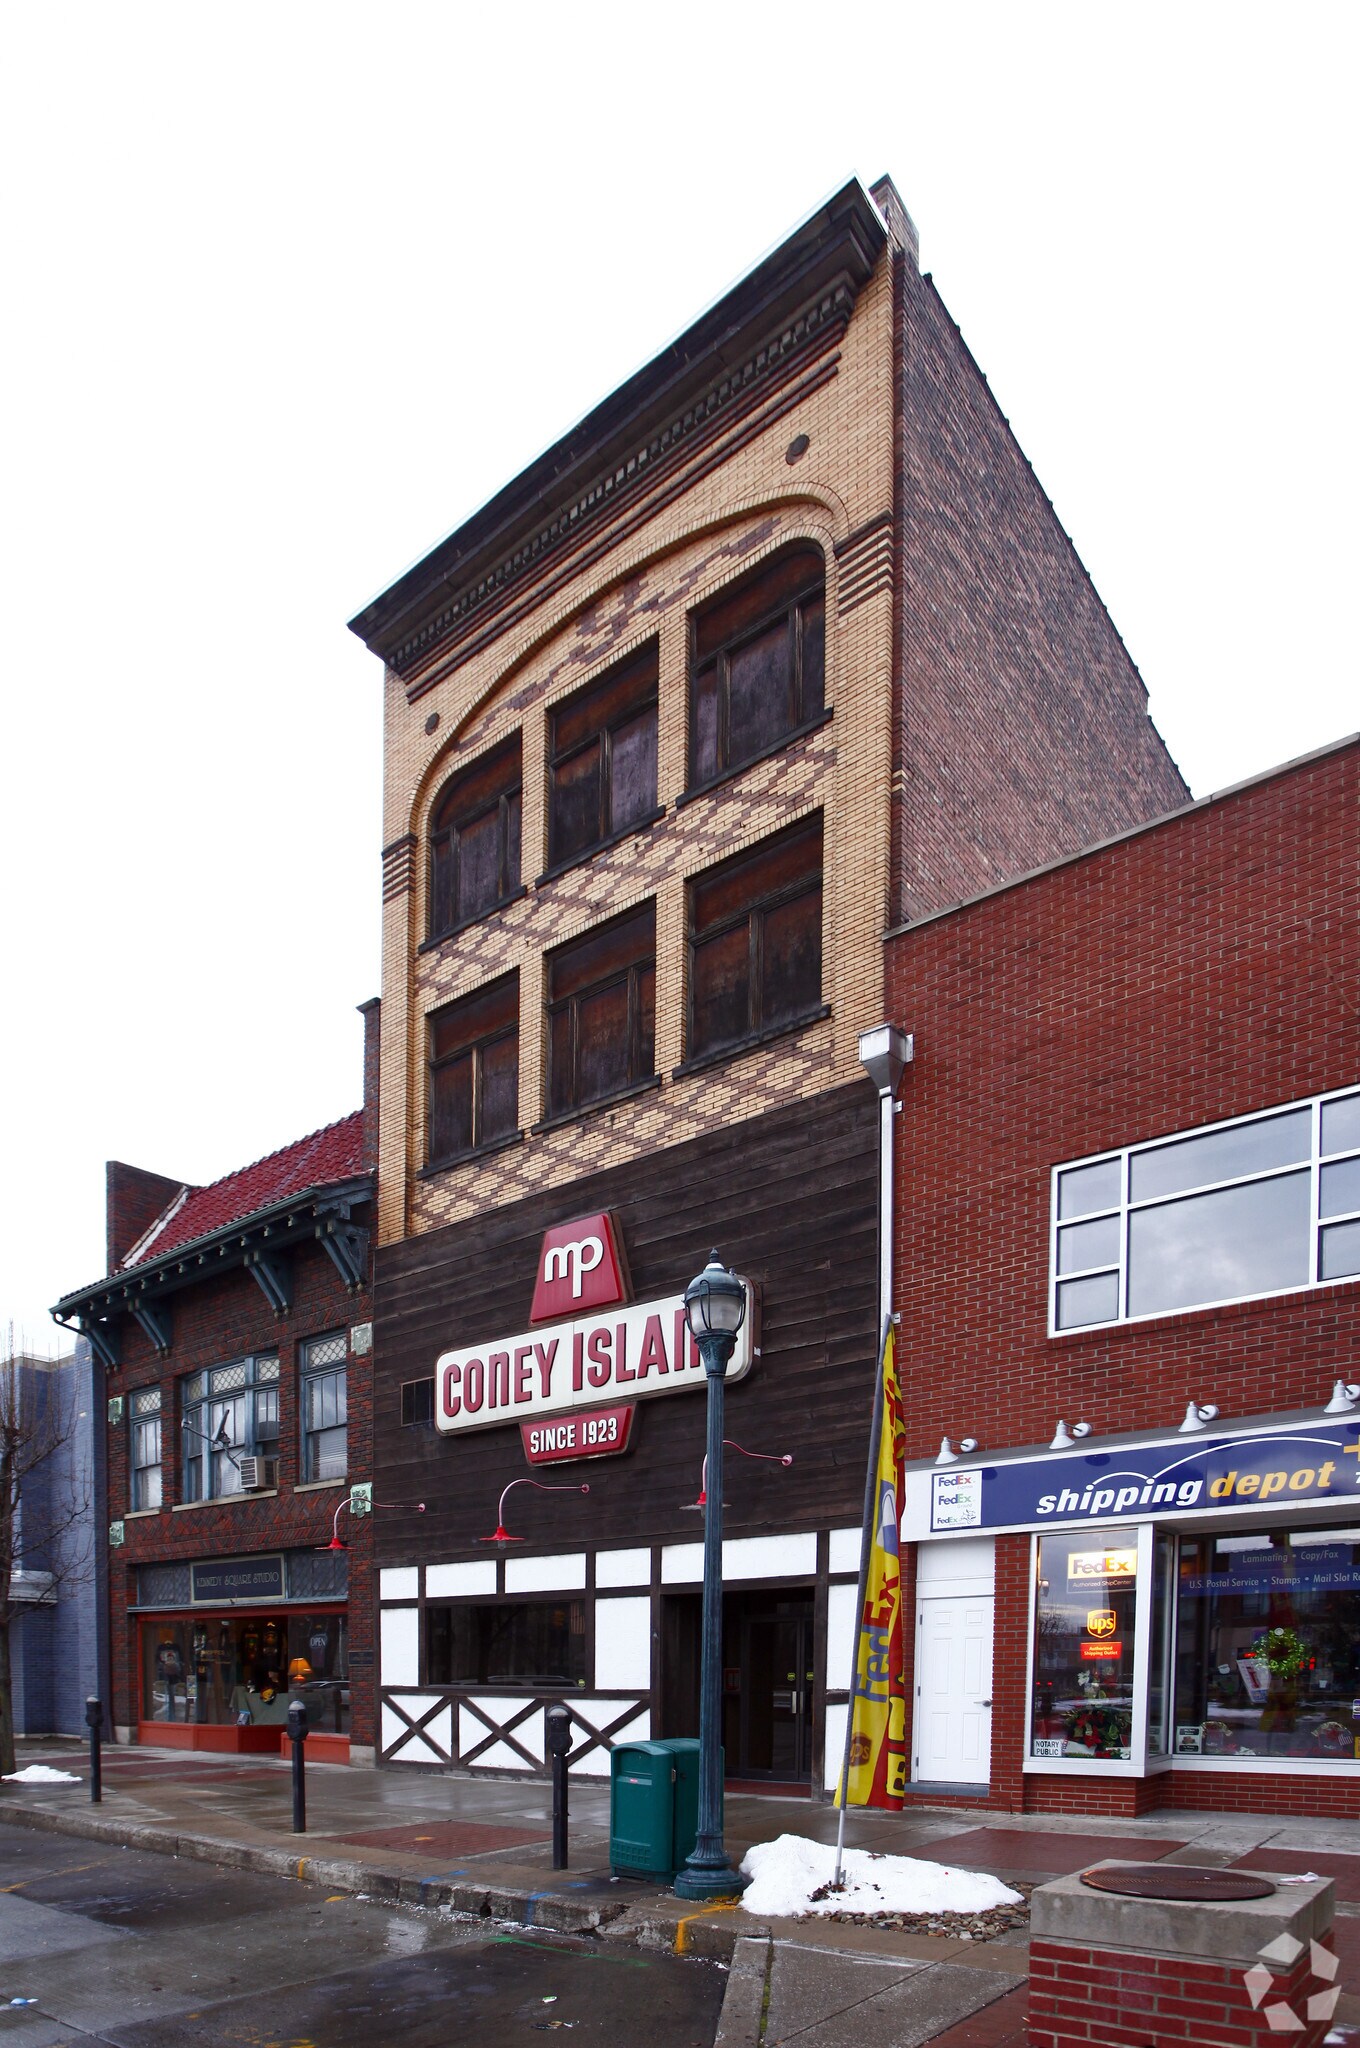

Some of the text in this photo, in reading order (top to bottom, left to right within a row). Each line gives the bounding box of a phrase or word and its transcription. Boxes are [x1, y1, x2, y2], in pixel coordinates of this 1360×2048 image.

[572, 1308, 735, 1392] ISLAN
[530, 1417, 618, 1455] SINCE 1923
[938, 1474, 972, 1487] FedEx
[1036, 1461, 1336, 1515] shipping depot
[938, 1493, 972, 1506] FedEx
[937, 1516, 958, 1524] FedEx
[1242, 1550, 1339, 1563] Laminating Copy/Fax
[1072, 1557, 1129, 1575] FedEx
[253, 1571, 280, 1584] STUDIO
[1189, 1580, 1204, 1589] U.S.
[1206, 1578, 1230, 1588] Postal
[1231, 1577, 1259, 1587] Service
[1271, 1576, 1301, 1586] Stamps
[1313, 1573, 1332, 1583] Mail
[1334, 1573, 1351, 1582] Slot
[1089, 1617, 1114, 1634] ups
[310, 1636, 326, 1647] OPEN
[853, 1571, 900, 1703] FedEx
[1035, 1740, 1060, 1748] NOTARY
[850, 1742, 870, 1763] ps
[1036, 1748, 1059, 1756] PUBLIC
